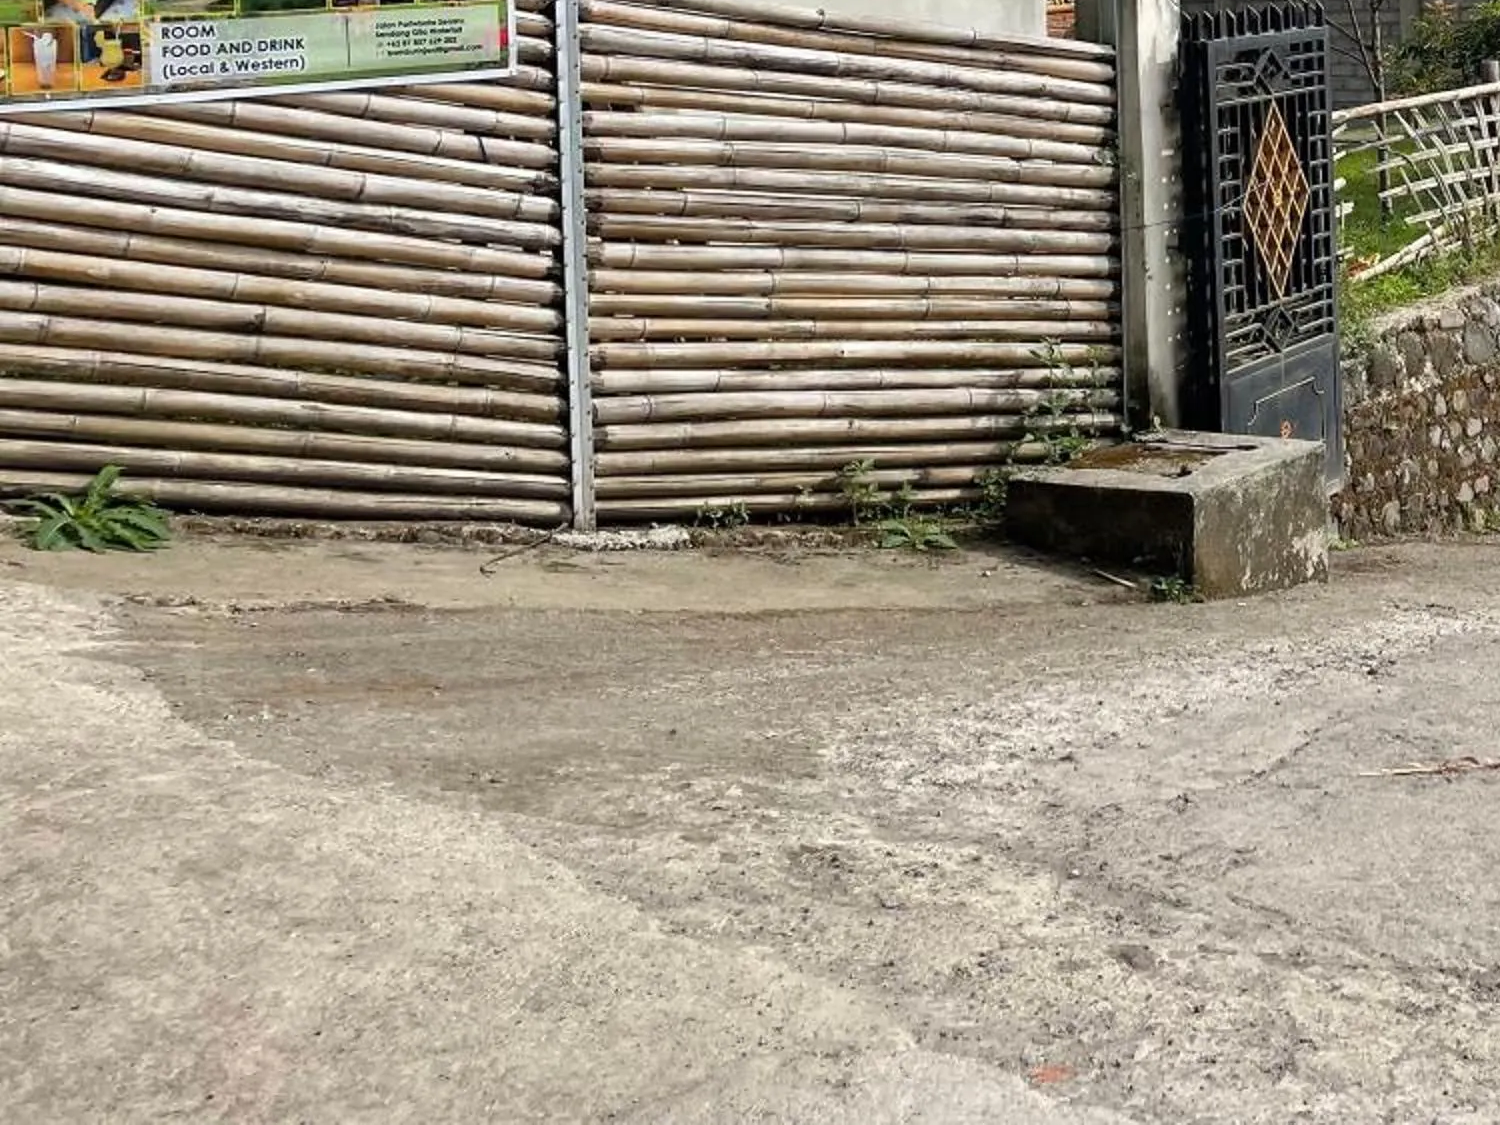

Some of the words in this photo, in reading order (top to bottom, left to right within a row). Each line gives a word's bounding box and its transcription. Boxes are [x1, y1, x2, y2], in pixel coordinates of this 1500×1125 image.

[161, 25, 216, 40] ROOM
[161, 44, 211, 58] FOOD
[215, 41, 252, 55] AND
[257, 38, 306, 52] DRINK
[162, 62, 215, 80] (Local
[219, 61, 229, 74] &
[235, 55, 306, 72] Western)
